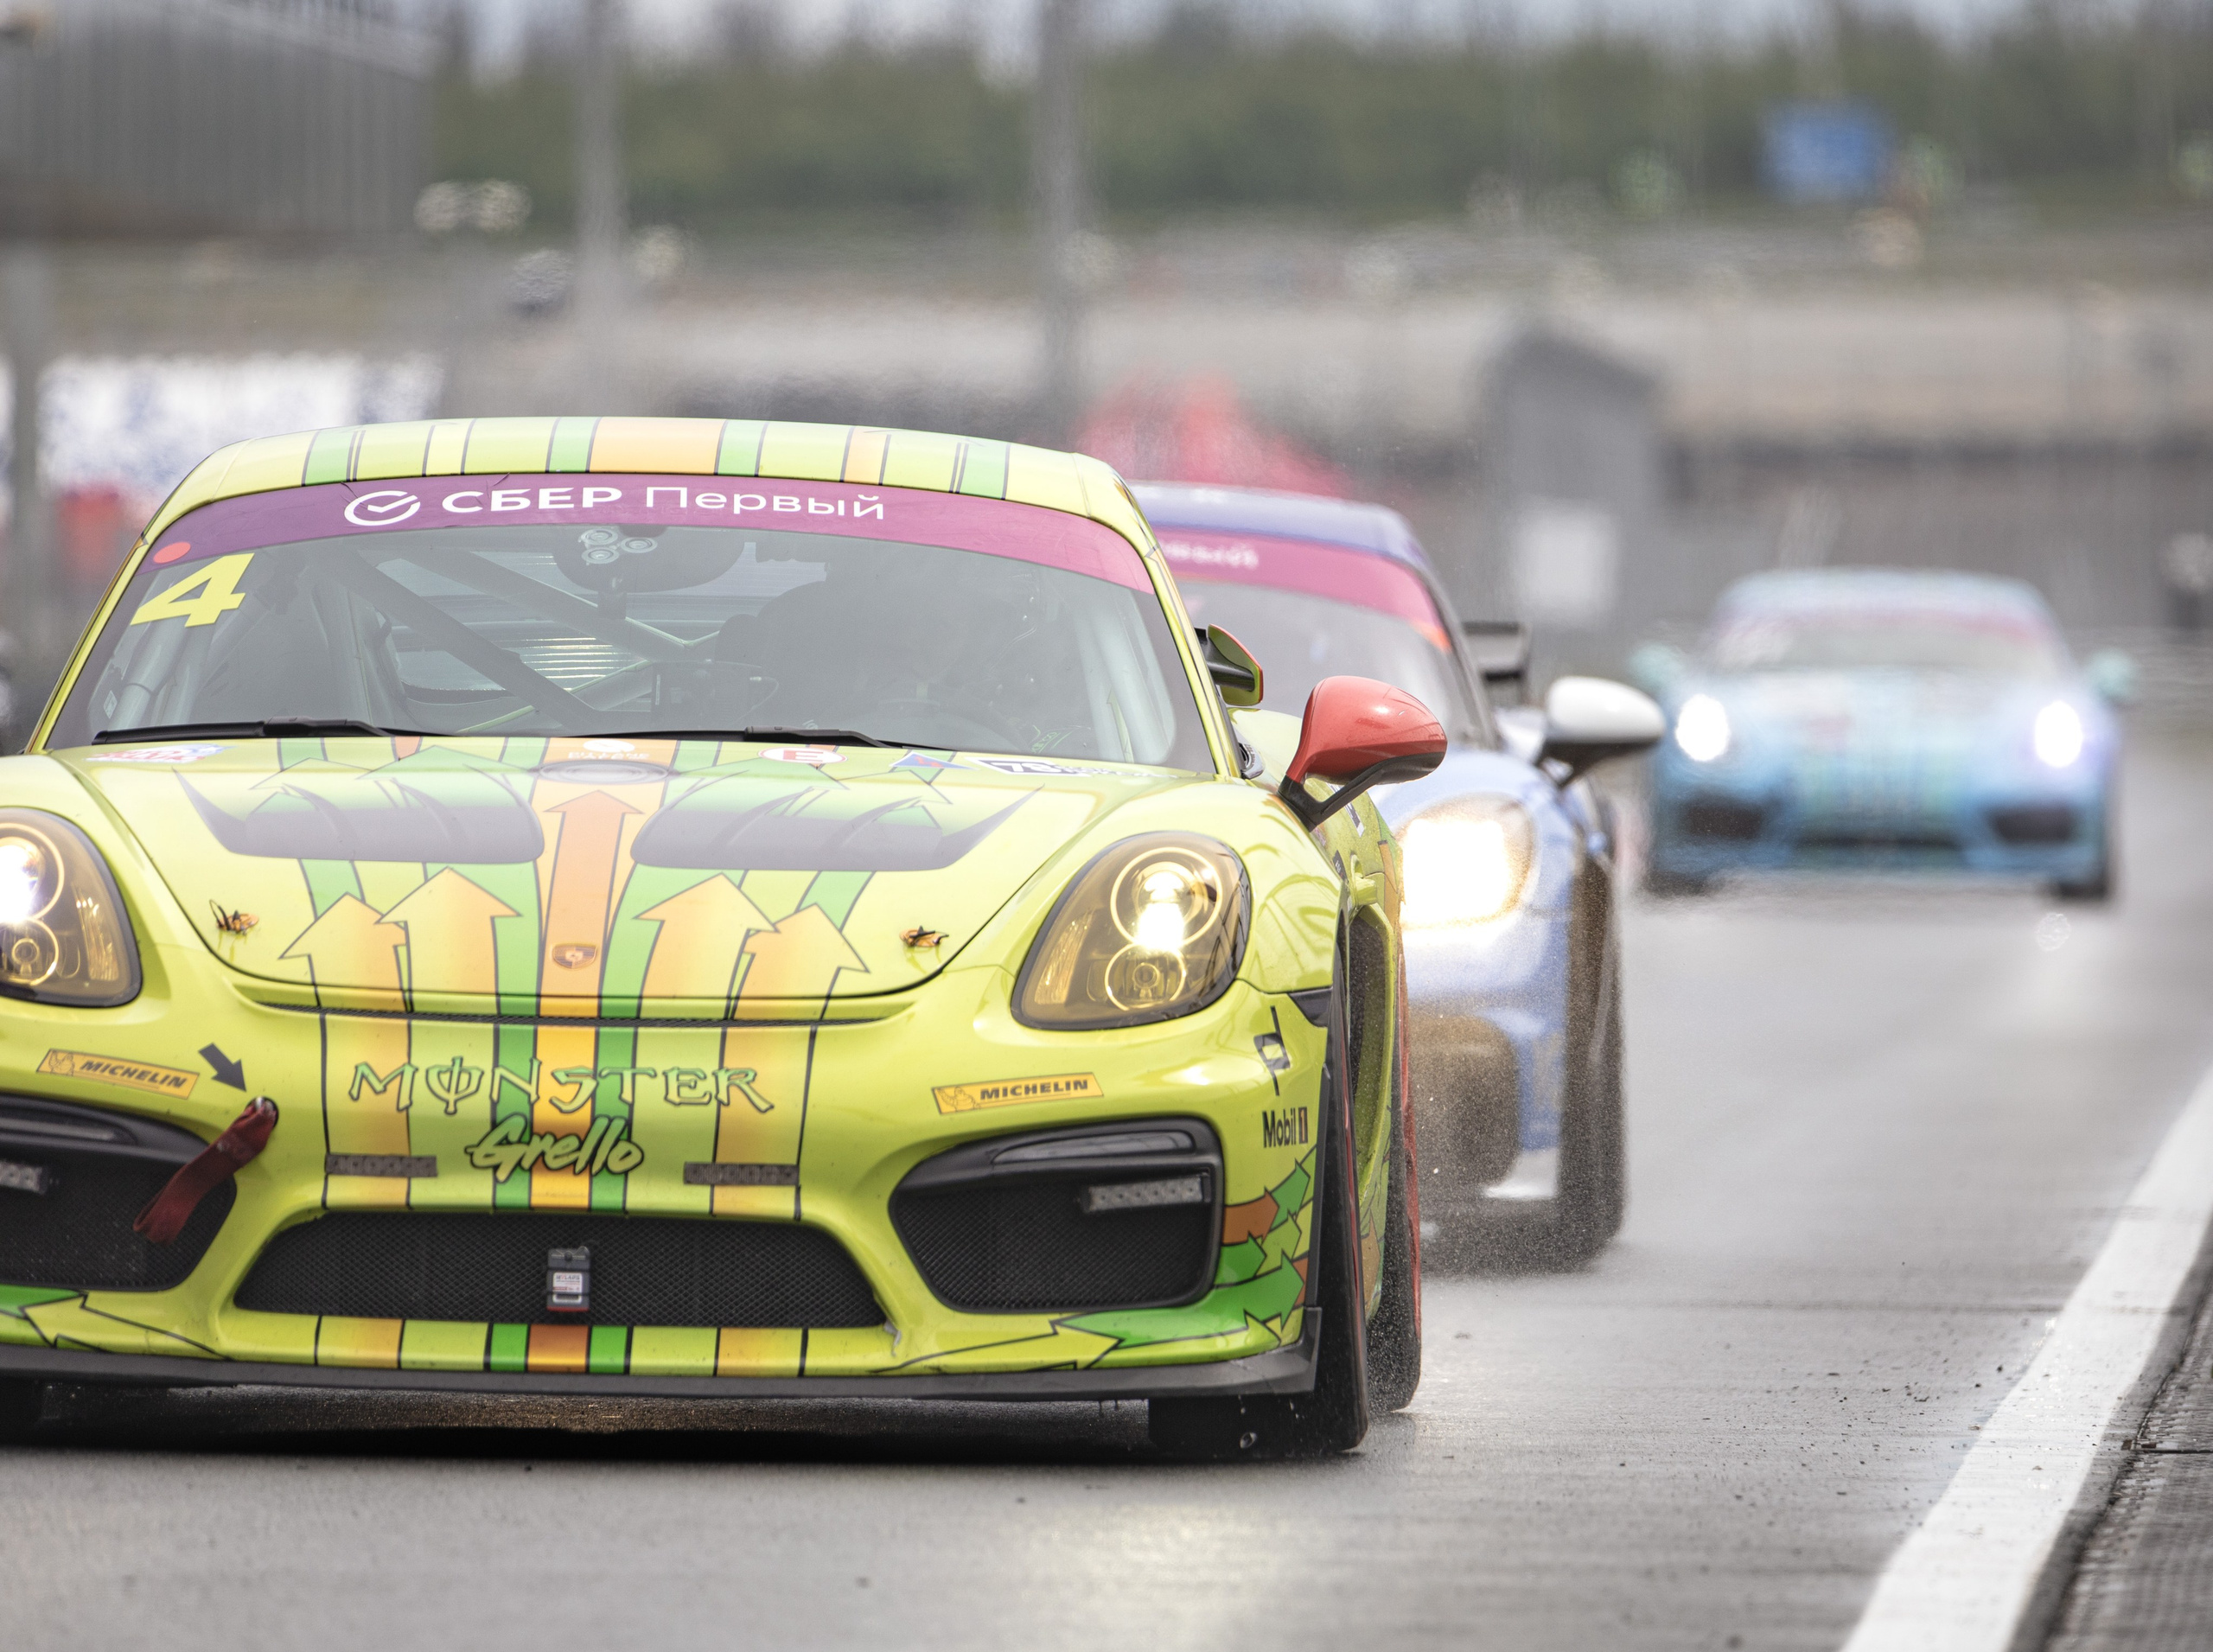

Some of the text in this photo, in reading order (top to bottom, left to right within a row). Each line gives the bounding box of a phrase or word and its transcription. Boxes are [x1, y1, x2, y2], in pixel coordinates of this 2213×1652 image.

[442, 487, 883, 520] СБЕР Первый
[130, 552, 254, 628] 4
[80, 1060, 187, 1088] MICHELIN
[980, 1079, 1087, 1100] MICHELIN
[465, 1113, 643, 1183] Grello
